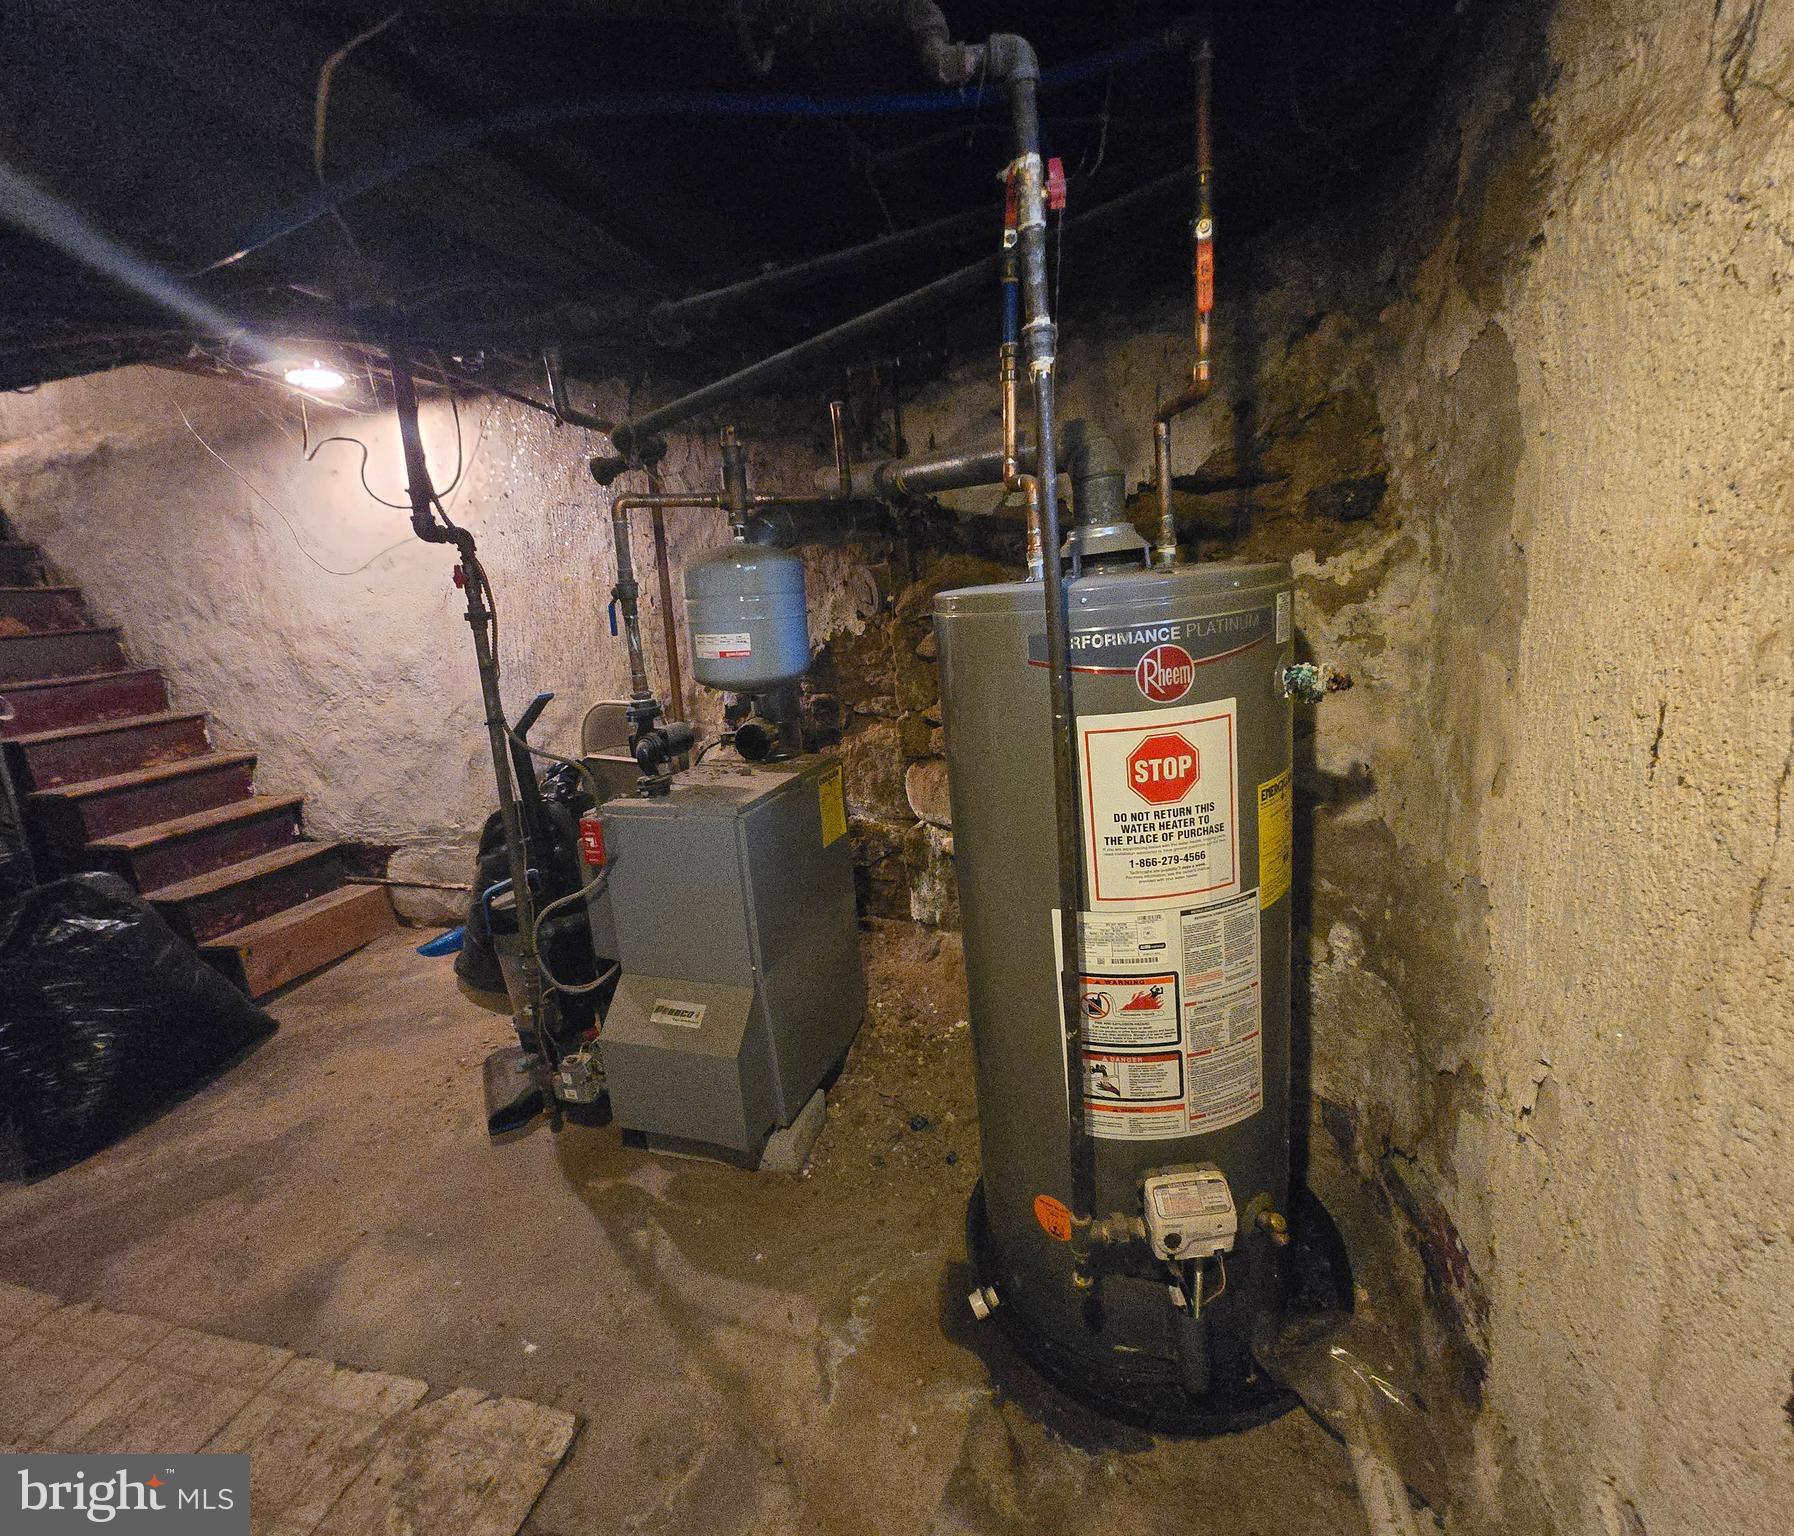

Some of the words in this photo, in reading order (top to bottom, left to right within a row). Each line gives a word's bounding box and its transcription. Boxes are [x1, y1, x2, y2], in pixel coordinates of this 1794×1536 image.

[1070, 626, 1181, 649] RFORMANCE
[1143, 648, 1191, 694] Rheem
[1134, 755, 1193, 783] STOP
[1113, 813, 1127, 823] DO
[1130, 811, 1150, 822] NOT
[1154, 806, 1192, 820] RETURN
[1195, 802, 1215, 814] THIS
[1104, 836, 1123, 846] THE
[1127, 834, 1158, 845] PLACE
[1162, 832, 1174, 842] OF
[1177, 822, 1225, 840] PURCHASE
[1121, 823, 1156, 834] WATER
[1159, 817, 1195, 831] HEATER
[1198, 815, 1210, 825] TO
[1129, 850, 1206, 868] 1-866-279-4566
